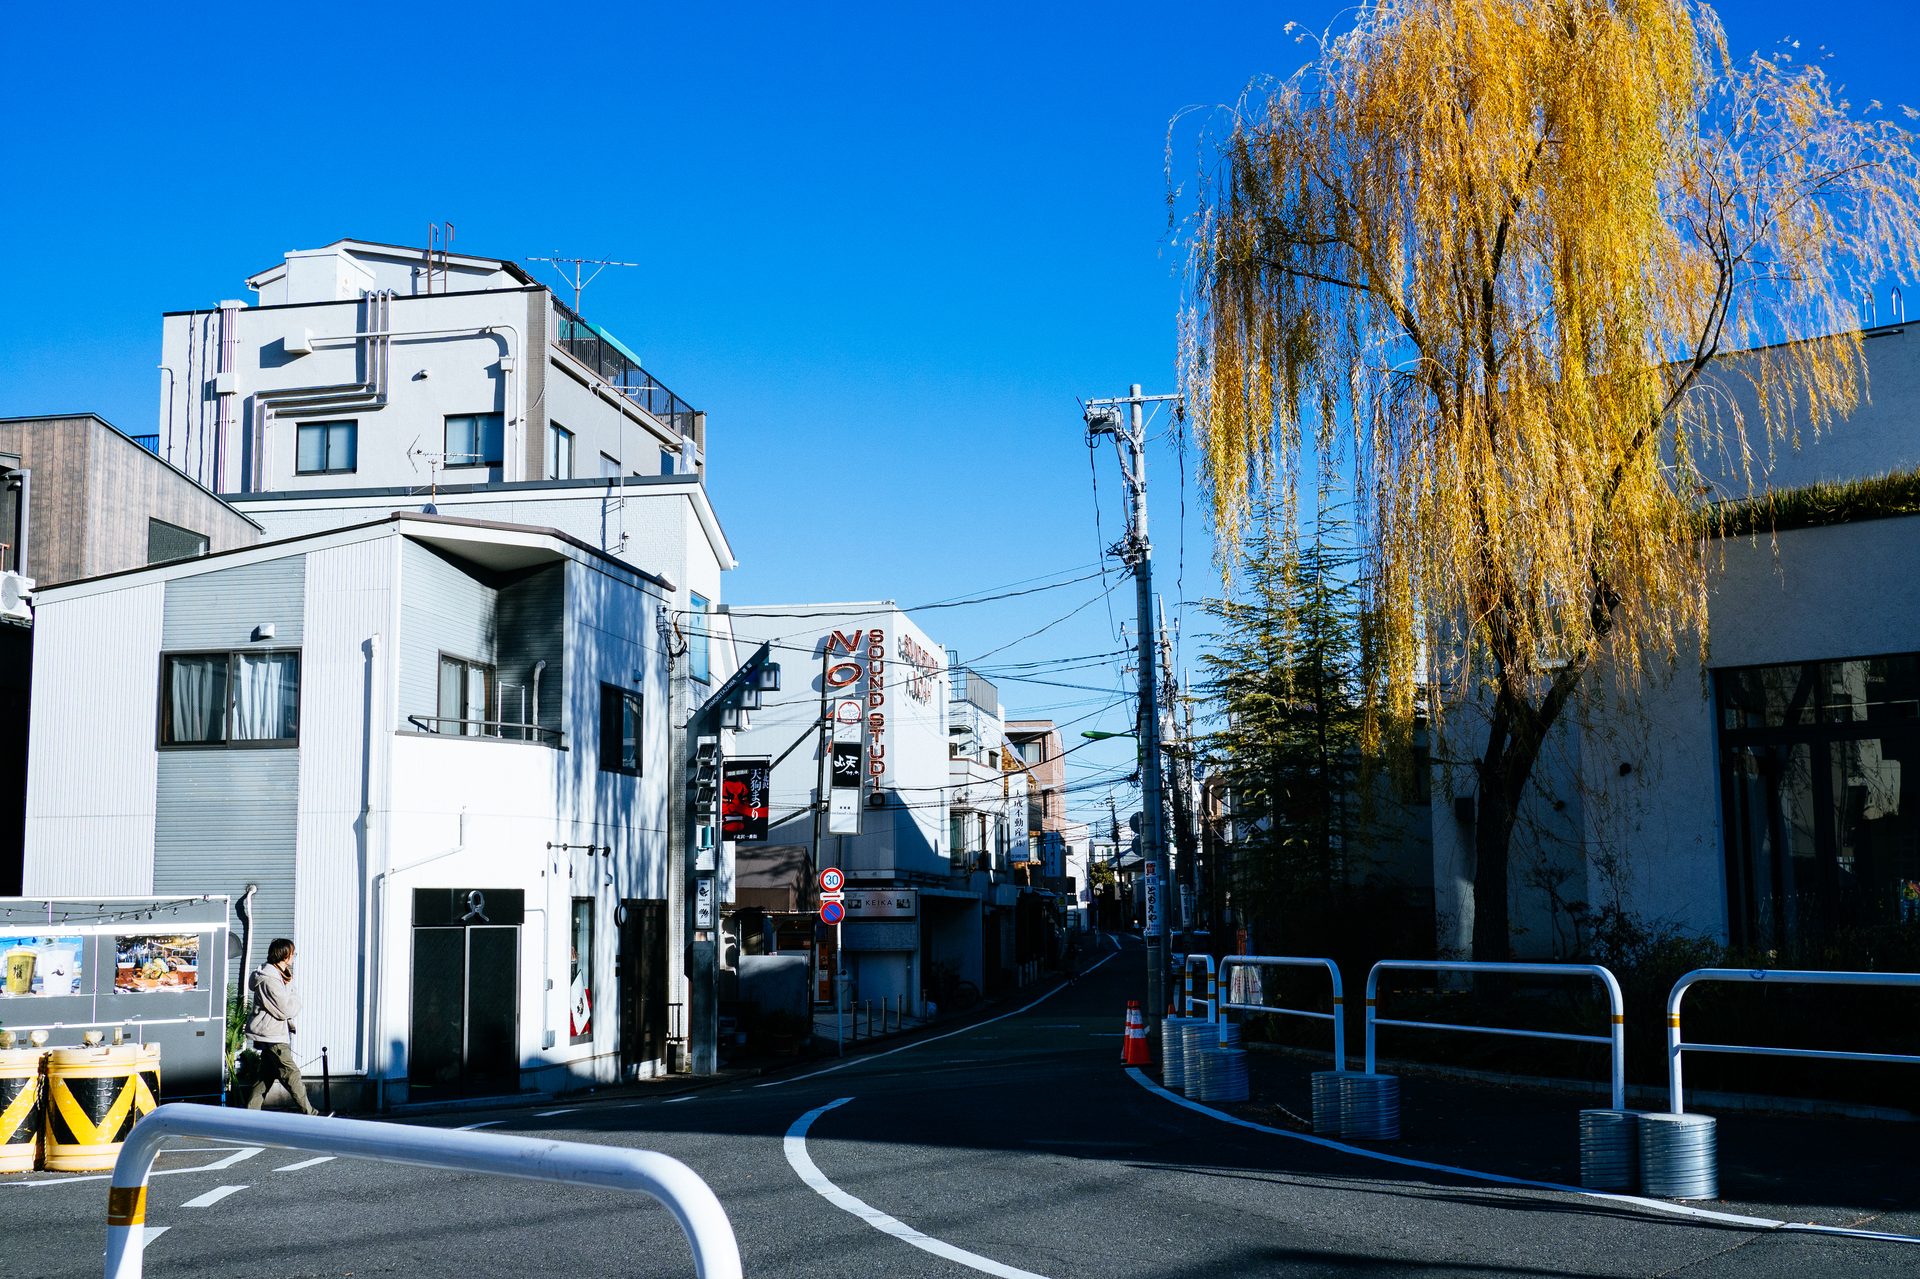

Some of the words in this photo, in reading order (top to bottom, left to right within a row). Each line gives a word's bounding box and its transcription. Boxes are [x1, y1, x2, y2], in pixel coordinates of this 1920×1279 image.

[868, 629, 885, 708] SOUND
[868, 713, 886, 806] STUDIO
[750, 768, 762, 821] 天狗まつり
[825, 874, 839, 886] 30
